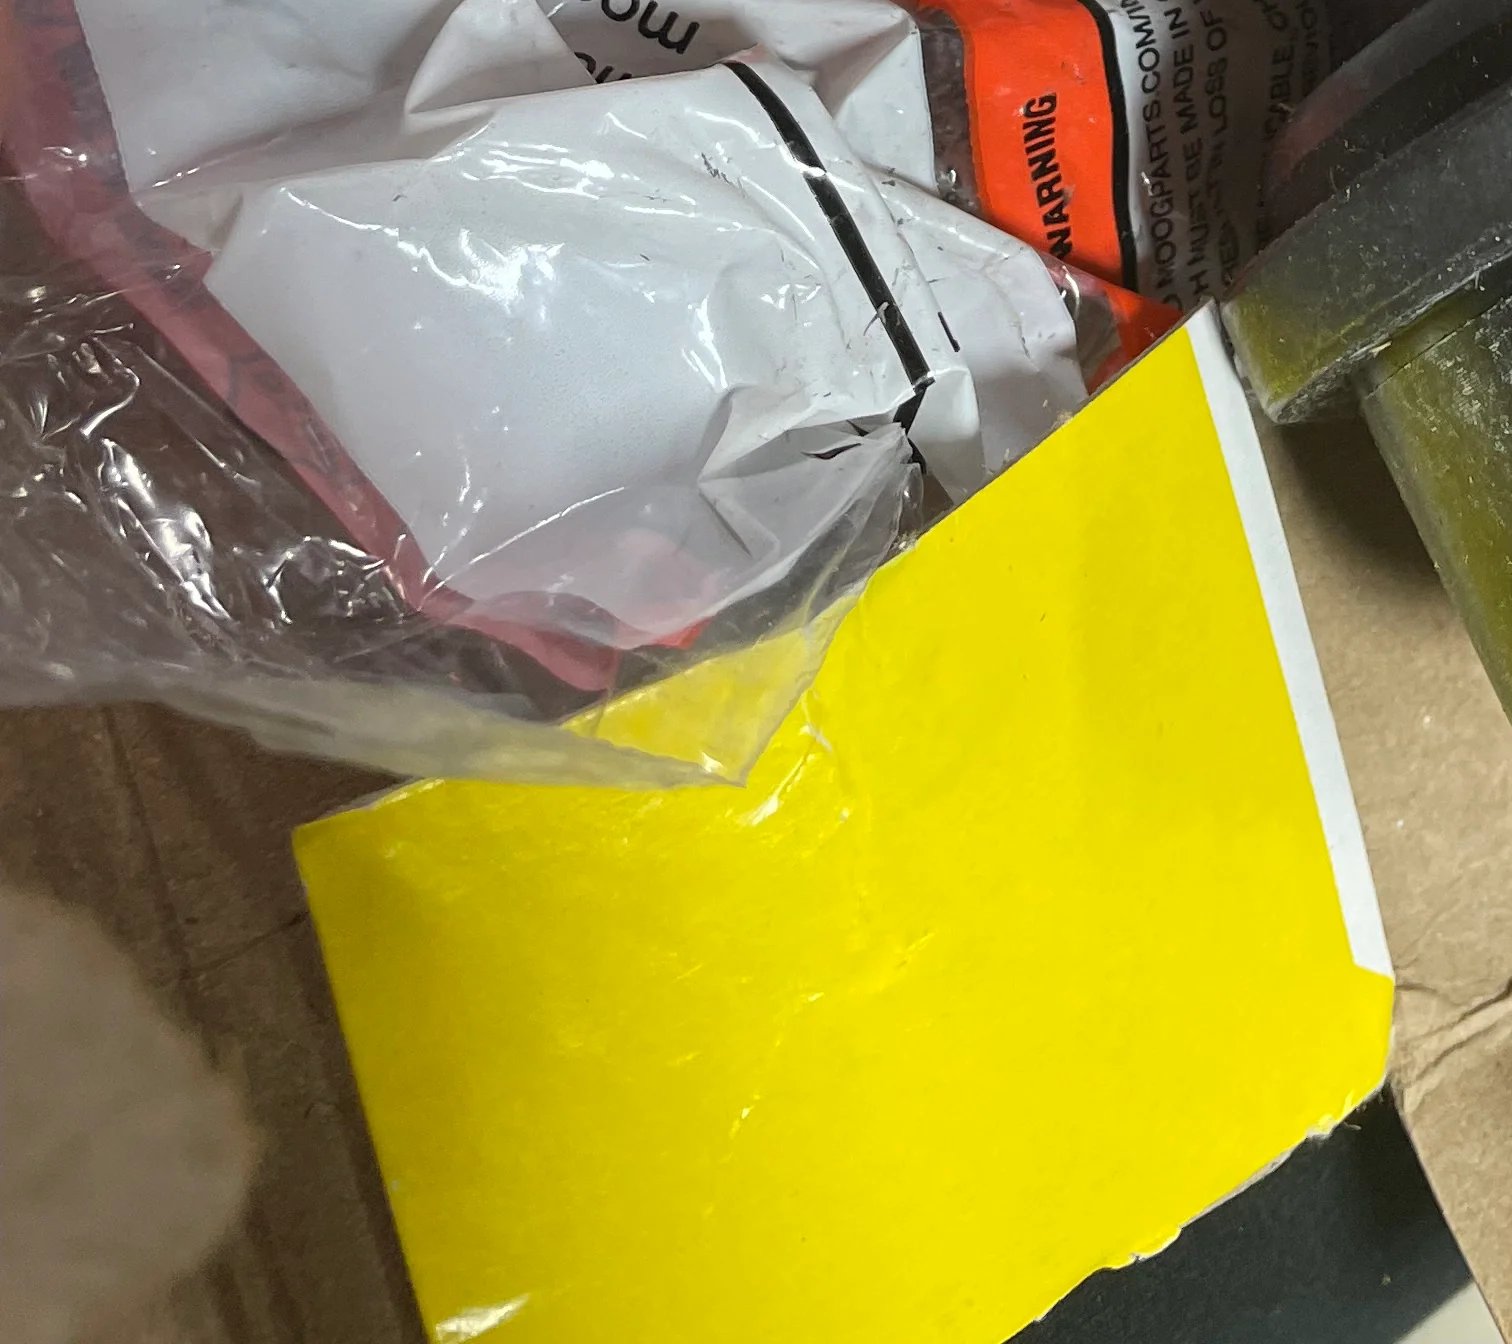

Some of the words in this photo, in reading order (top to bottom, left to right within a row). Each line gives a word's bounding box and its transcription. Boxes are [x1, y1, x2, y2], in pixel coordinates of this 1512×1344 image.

[1165, 9, 1187, 39] IN
[1202, 9, 1226, 50] OF
[1174, 45, 1197, 132] MADE
[1023, 91, 1073, 257] WARNING
